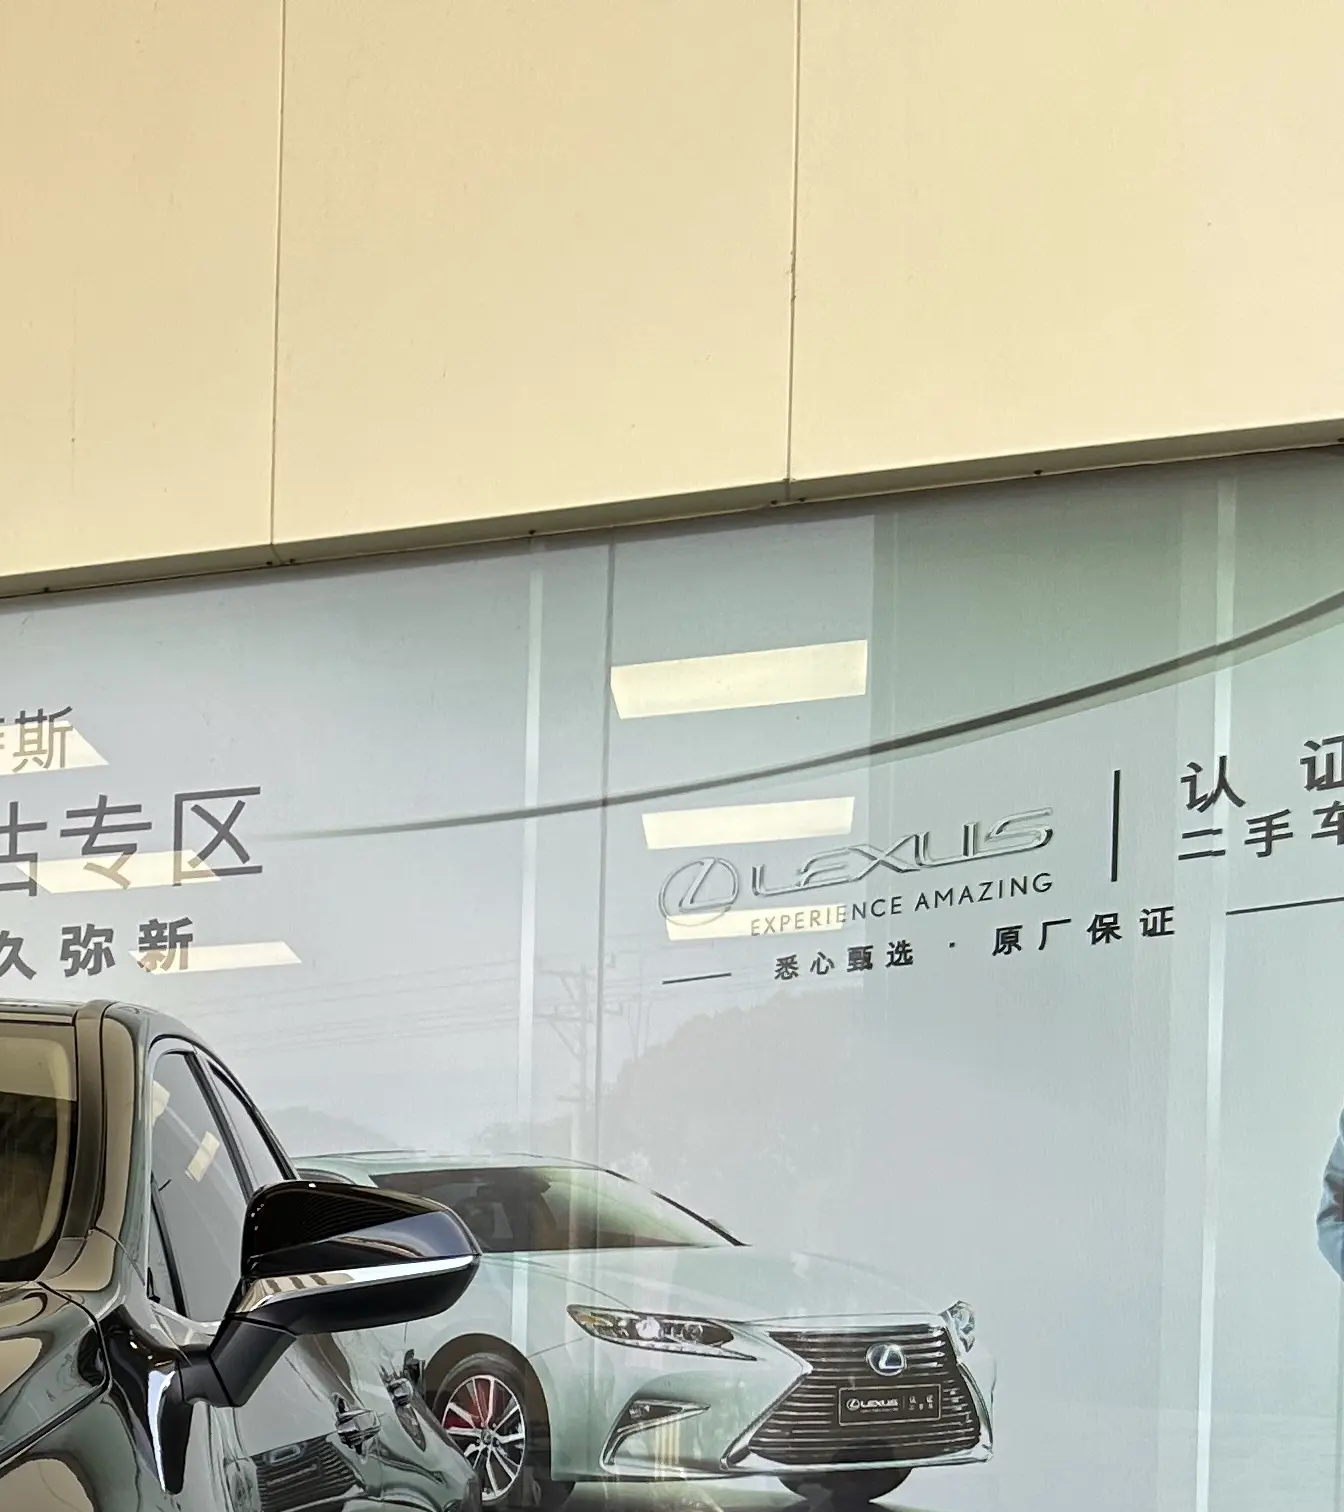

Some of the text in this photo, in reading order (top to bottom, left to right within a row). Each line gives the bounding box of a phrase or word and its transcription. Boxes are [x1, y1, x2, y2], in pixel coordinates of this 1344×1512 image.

[1179, 737, 1344, 813] 认证
[750, 806, 1054, 896] LEXUS
[750, 871, 1054, 938] EXPERIENCE AMAZING
[773, 904, 1176, 982] 悉心甄选 原厂保证
